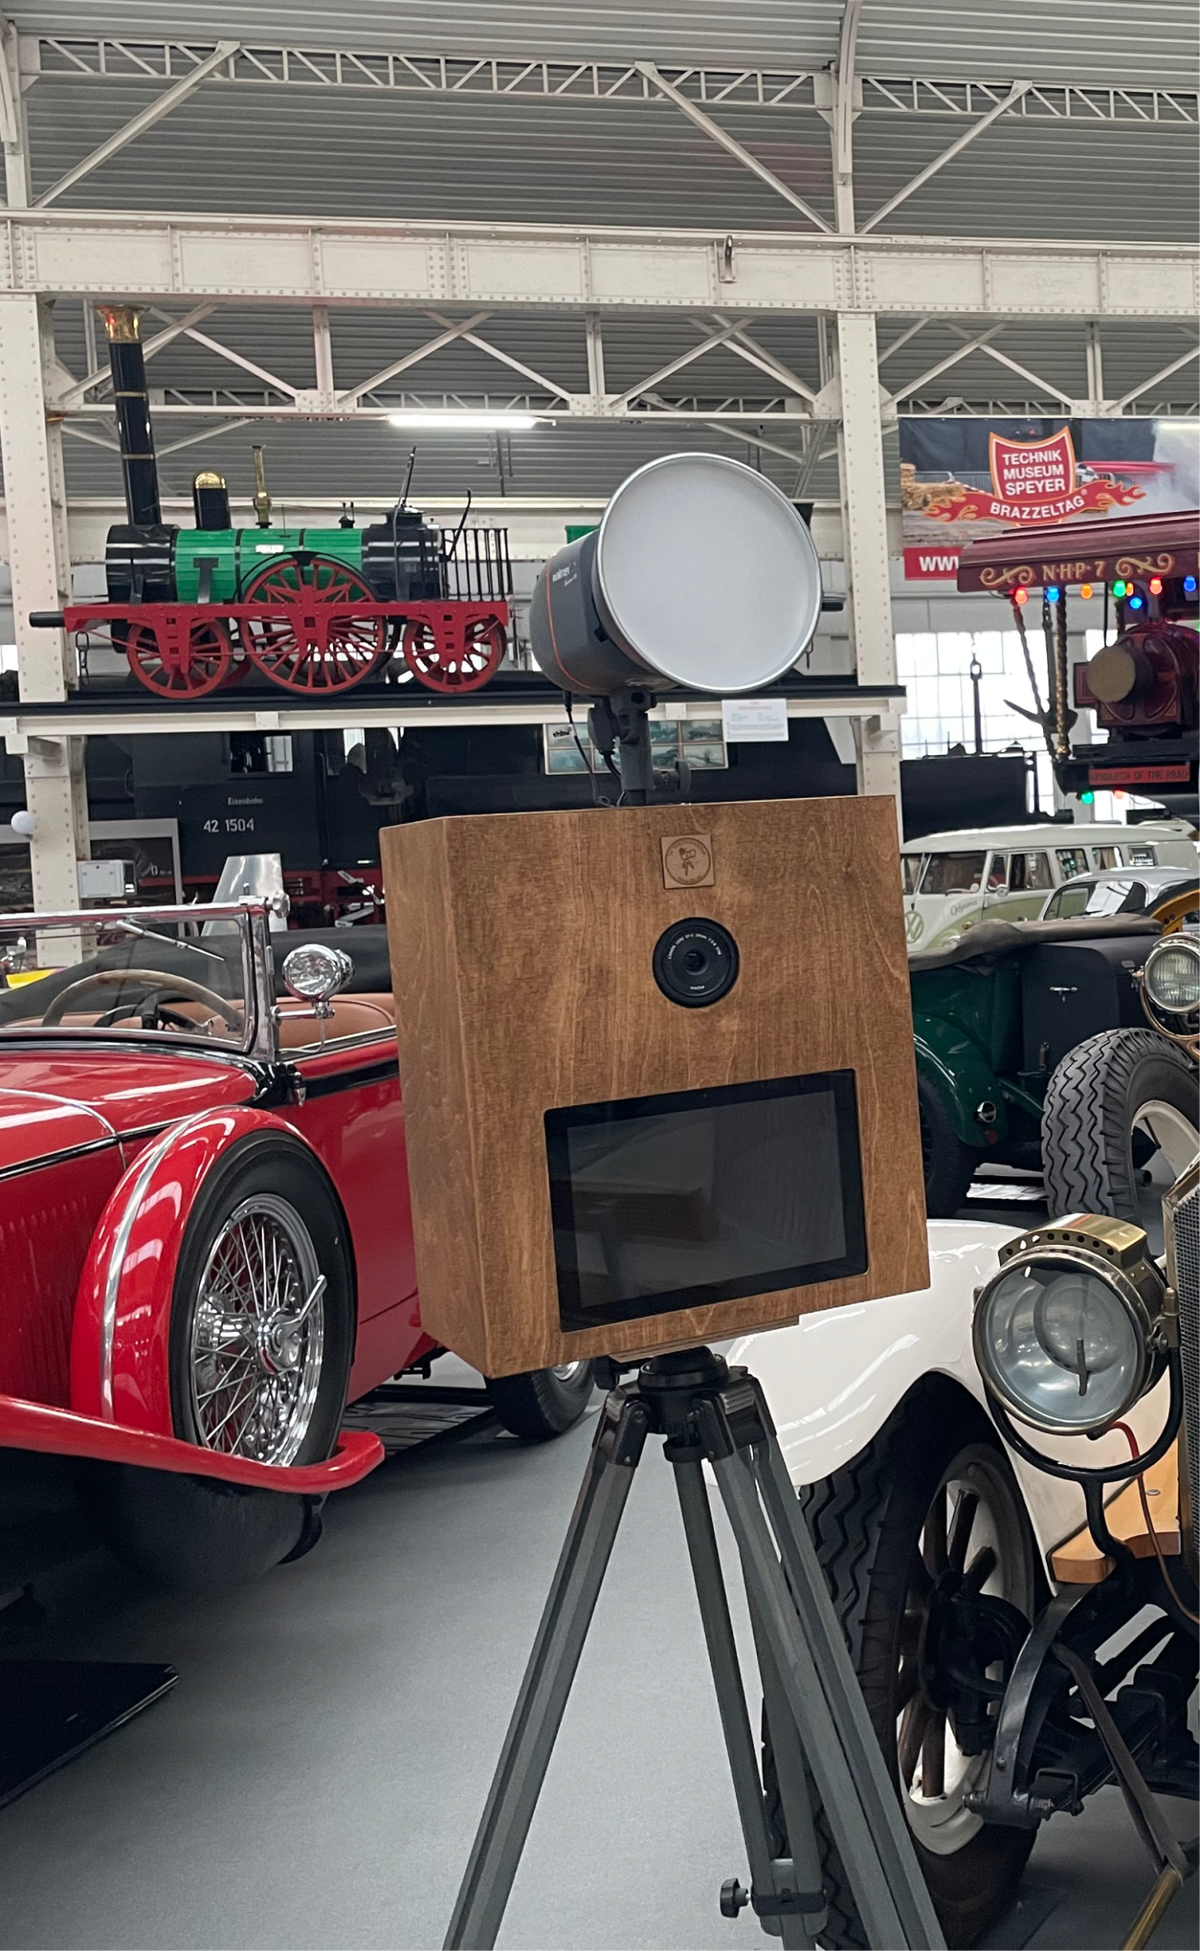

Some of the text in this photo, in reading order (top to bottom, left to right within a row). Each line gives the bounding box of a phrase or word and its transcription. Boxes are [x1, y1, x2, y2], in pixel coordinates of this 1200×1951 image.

[1002, 450, 1062, 465] TECHNIK
[1003, 464, 1064, 480] MUSEUM
[1005, 478, 1066, 496] SPEYER
[990, 495, 1085, 519] BRAZZELTAG
[203, 818, 255, 833] 42 1504
